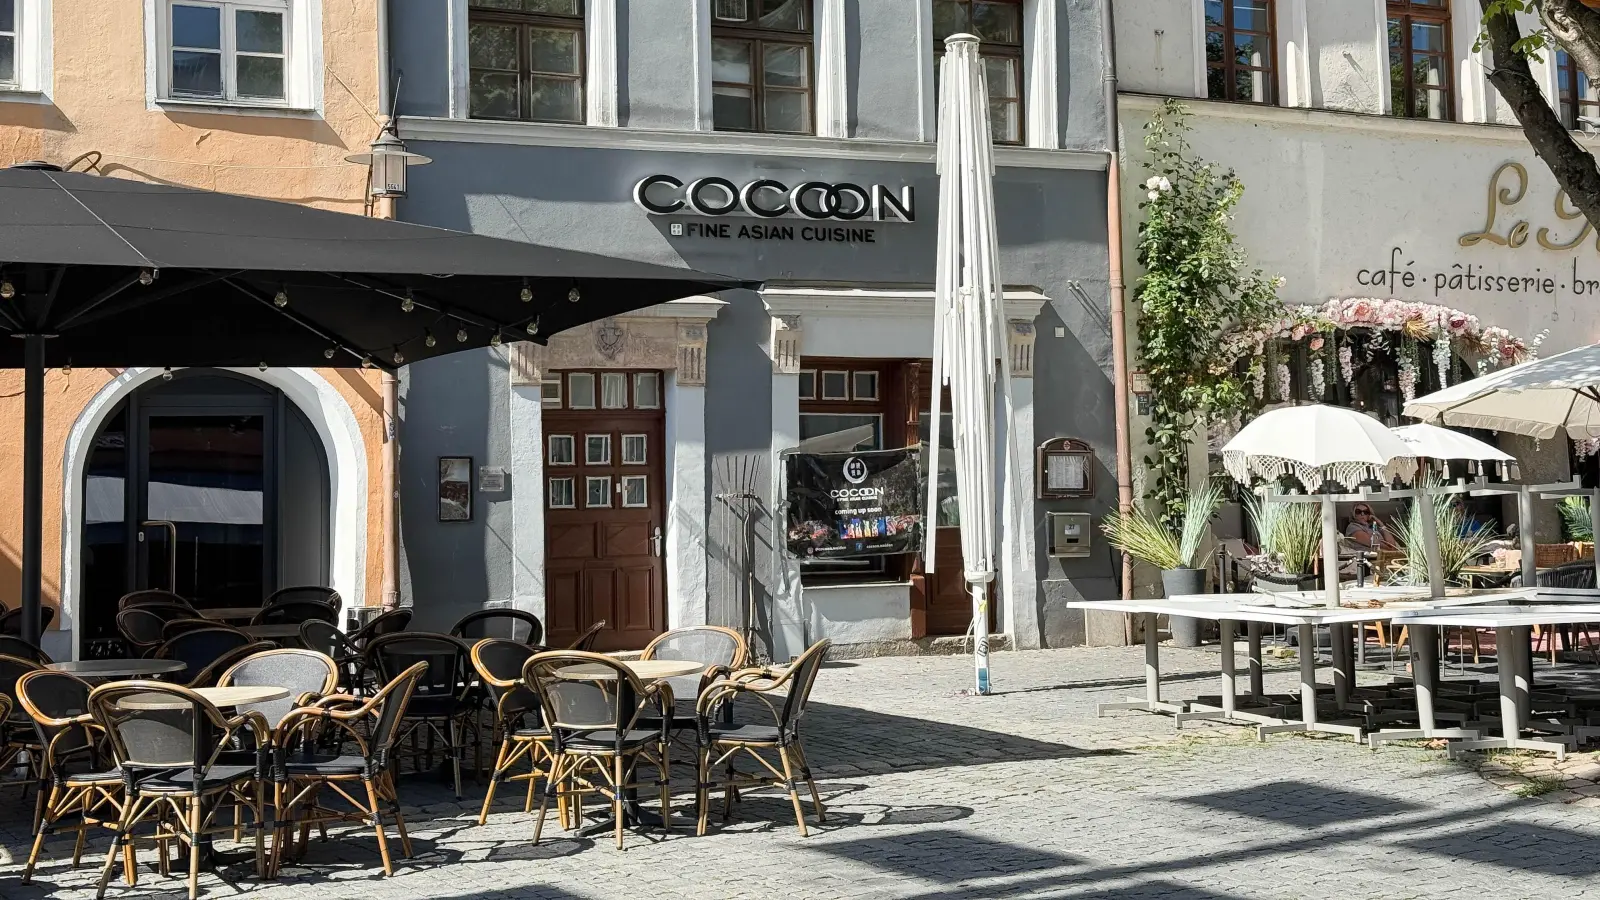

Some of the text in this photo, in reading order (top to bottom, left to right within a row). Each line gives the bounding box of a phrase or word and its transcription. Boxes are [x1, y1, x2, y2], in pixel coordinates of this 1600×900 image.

[633, 174, 915, 222] COCOON
[1458, 162, 1530, 249] Le
[687, 222, 875, 243] FINE ASIAN CUISINE
[1356, 246, 1600, 296] café pâtisserie br
[830, 486, 884, 498] COCOON
[858, 507, 866, 515] up
